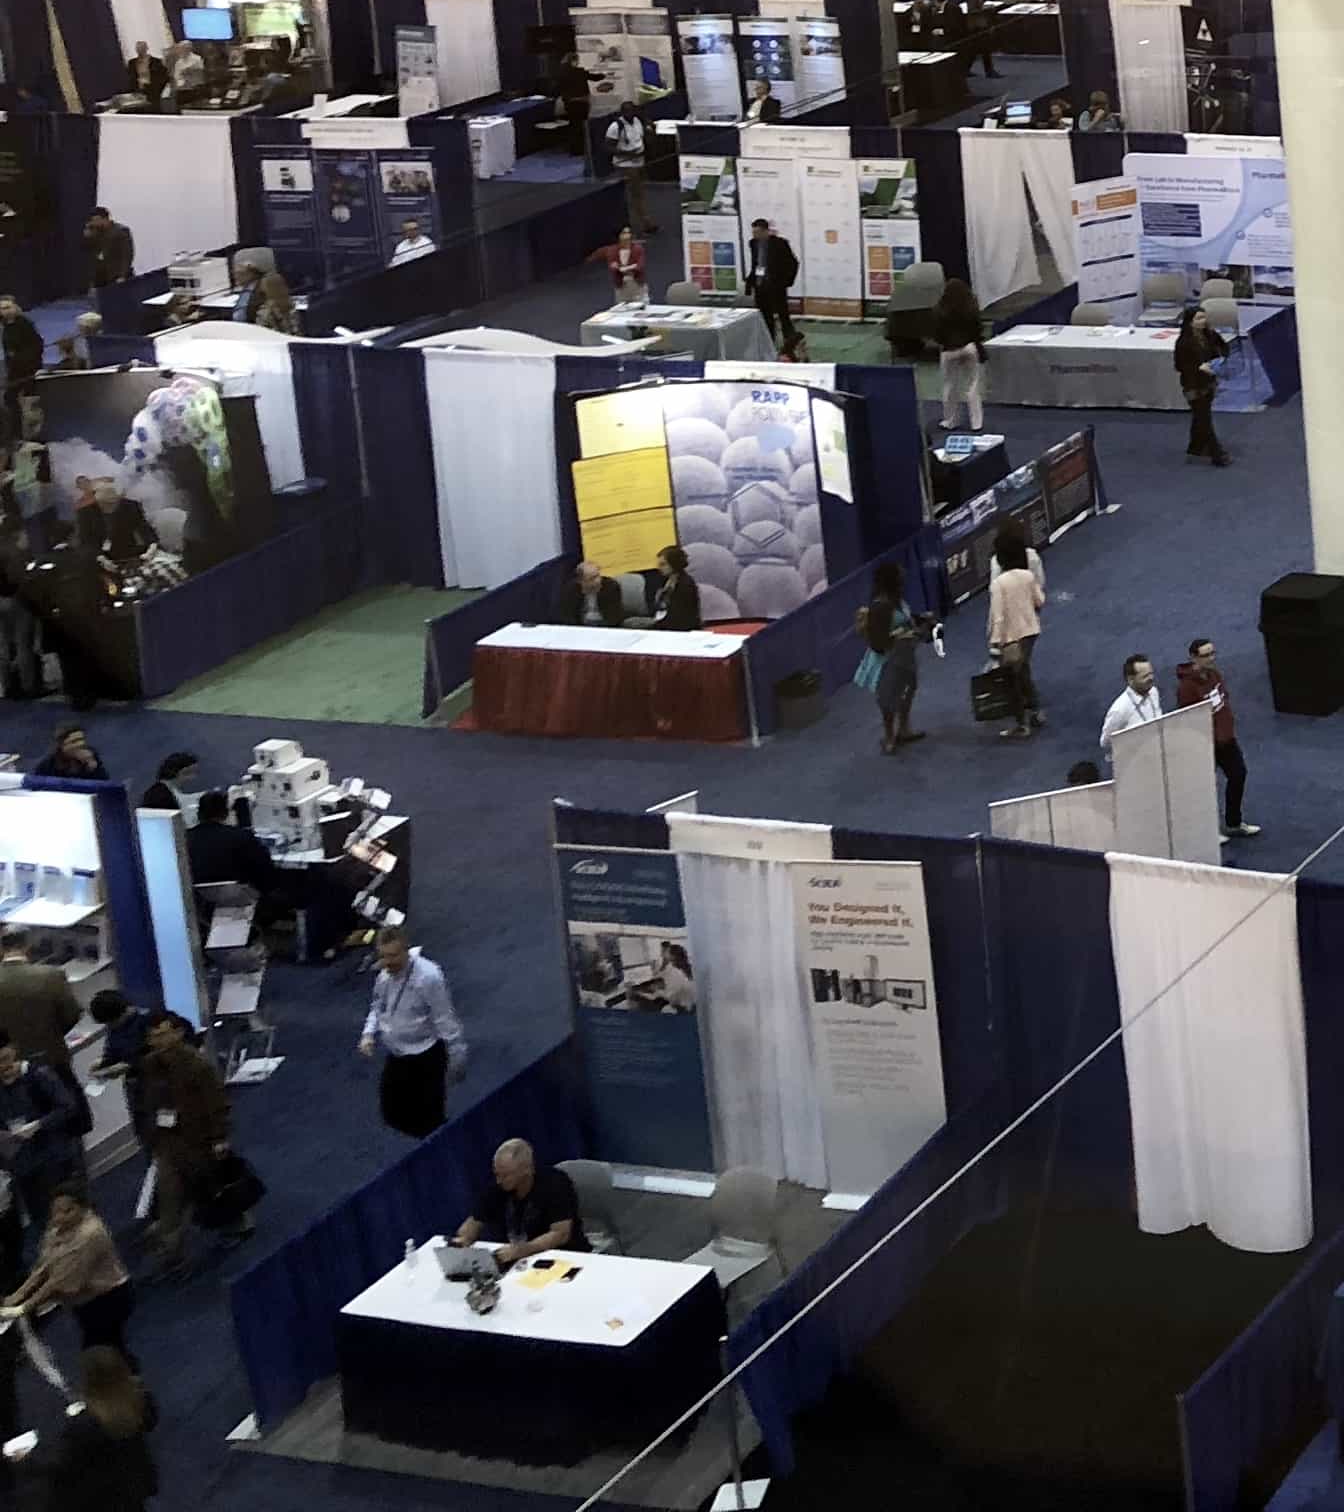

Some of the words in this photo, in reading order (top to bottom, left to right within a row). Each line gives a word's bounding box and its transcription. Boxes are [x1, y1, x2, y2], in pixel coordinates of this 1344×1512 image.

[807, 901, 830, 913] You
[832, 902, 889, 915] Designed
[830, 915, 899, 929] Engineered
